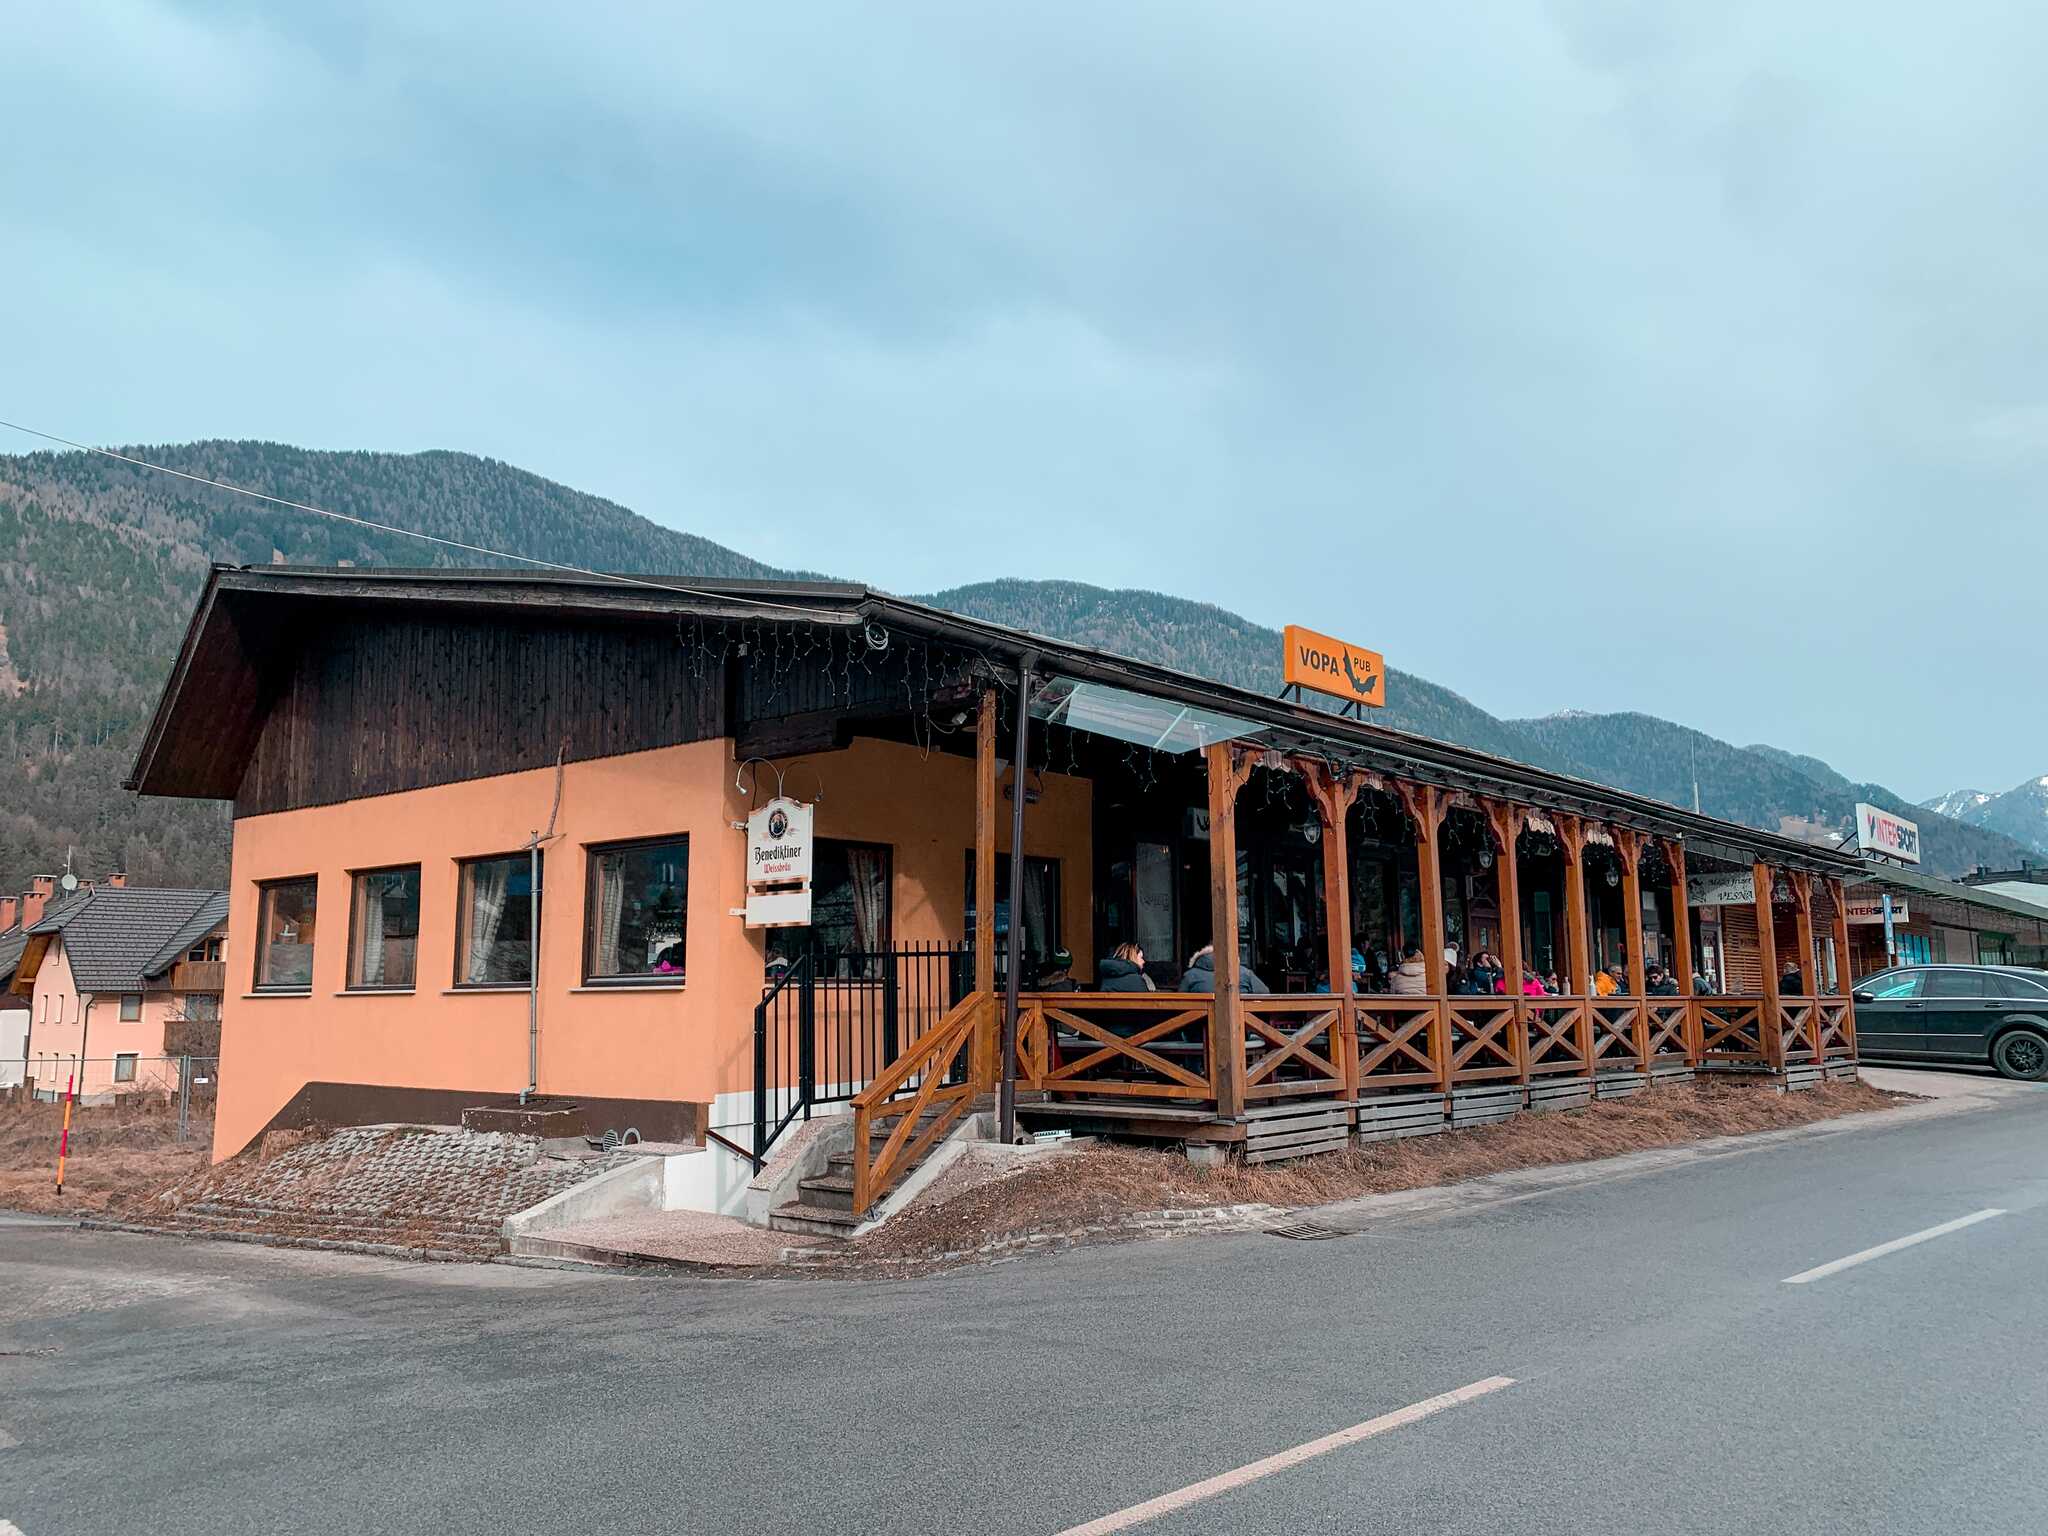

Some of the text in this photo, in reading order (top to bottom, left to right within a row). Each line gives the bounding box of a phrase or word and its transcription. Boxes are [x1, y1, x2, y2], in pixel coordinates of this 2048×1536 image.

[1300, 646, 1371, 676] VOPA PUB
[1876, 816, 1917, 854] INTERSPORT
[754, 845, 802, 864] Benediktiner
[1847, 906, 1903, 916] NTERSPRT
